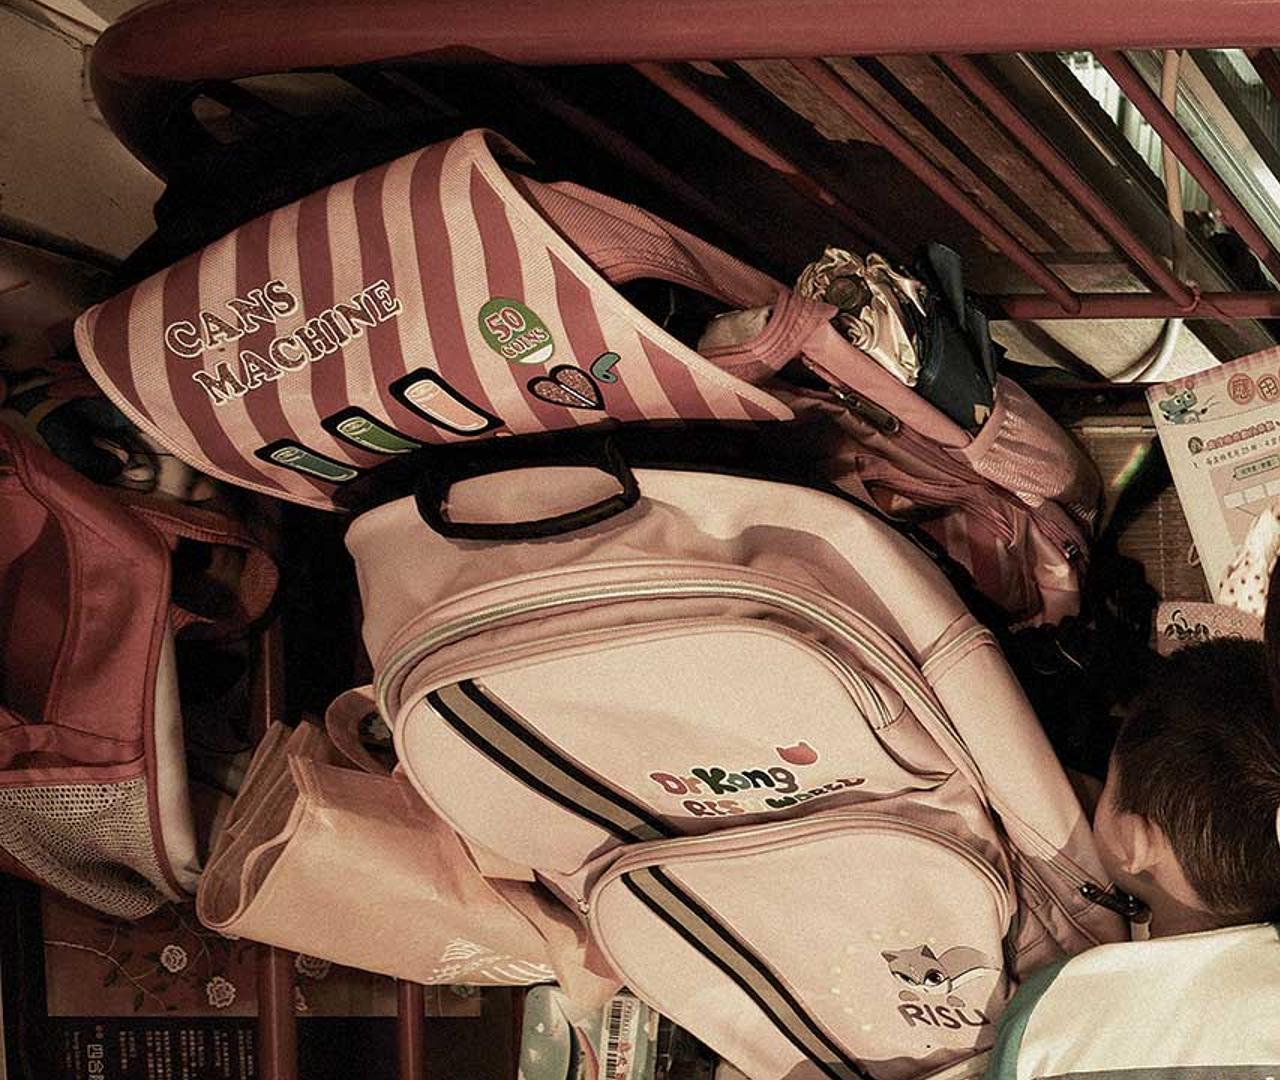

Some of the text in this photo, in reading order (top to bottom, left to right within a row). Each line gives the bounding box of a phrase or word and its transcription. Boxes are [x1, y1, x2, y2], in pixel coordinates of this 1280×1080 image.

[165, 280, 296, 357] CANS
[485, 307, 524, 341] 50
[194, 280, 403, 405] MACHINE
[501, 327, 549, 359] COINS
[897, 1003, 991, 1029] RISU
